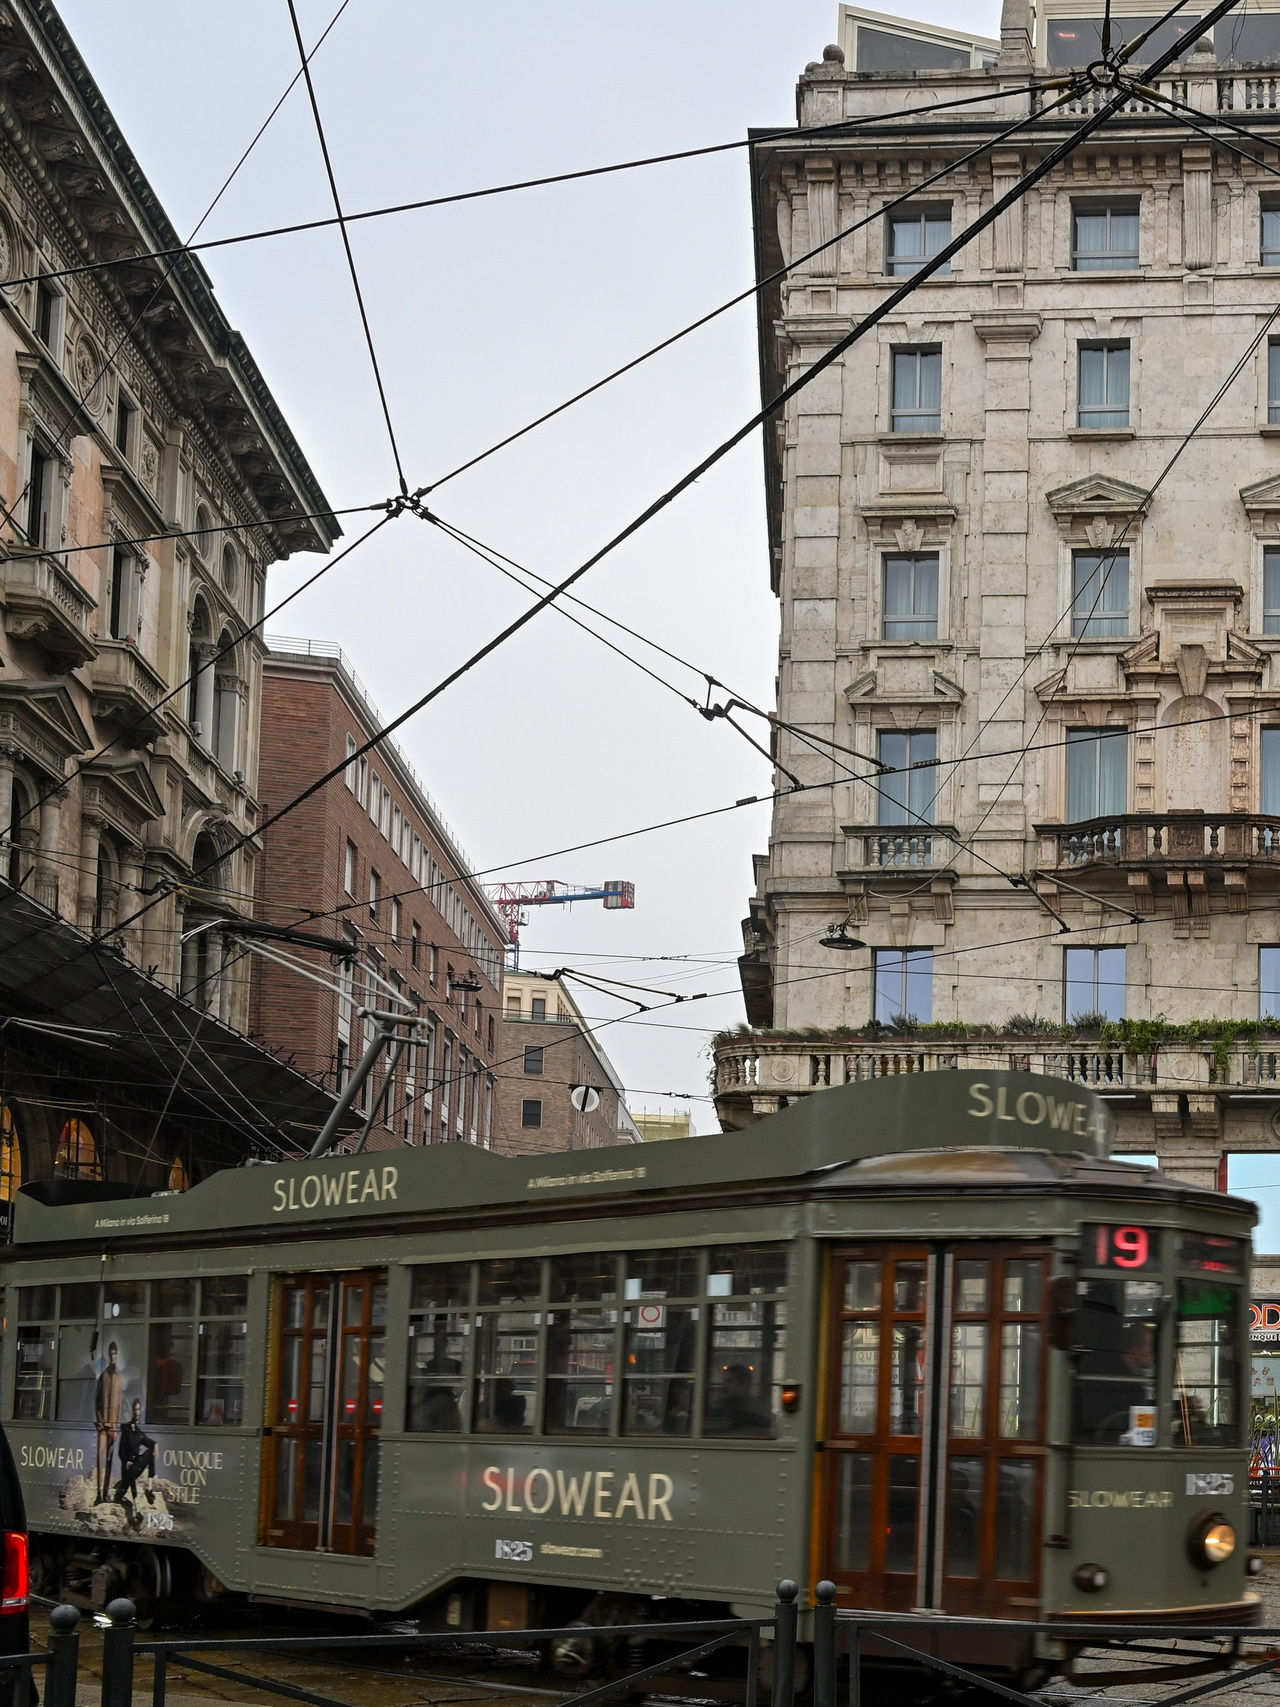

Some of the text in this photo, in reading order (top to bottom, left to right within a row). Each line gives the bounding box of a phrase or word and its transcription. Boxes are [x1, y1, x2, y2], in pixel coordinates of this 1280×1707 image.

[272, 1166, 398, 1212] SLOWEAR
[95, 1214, 169, 1228] A Milano in via Solferino 18
[1096, 1224, 1149, 1268] 19
[20, 1446, 83, 1470] SLOWEAR
[162, 1450, 223, 1470] OVUNQUE
[180, 1468, 207, 1486] CON
[1185, 1473, 1234, 1496] 1825
[481, 1466, 674, 1521] SLOWEAR
[1067, 1490, 1174, 1508] SLOWEAR
[147, 1512, 175, 1531] 1825
[495, 1539, 533, 1561] 1825
